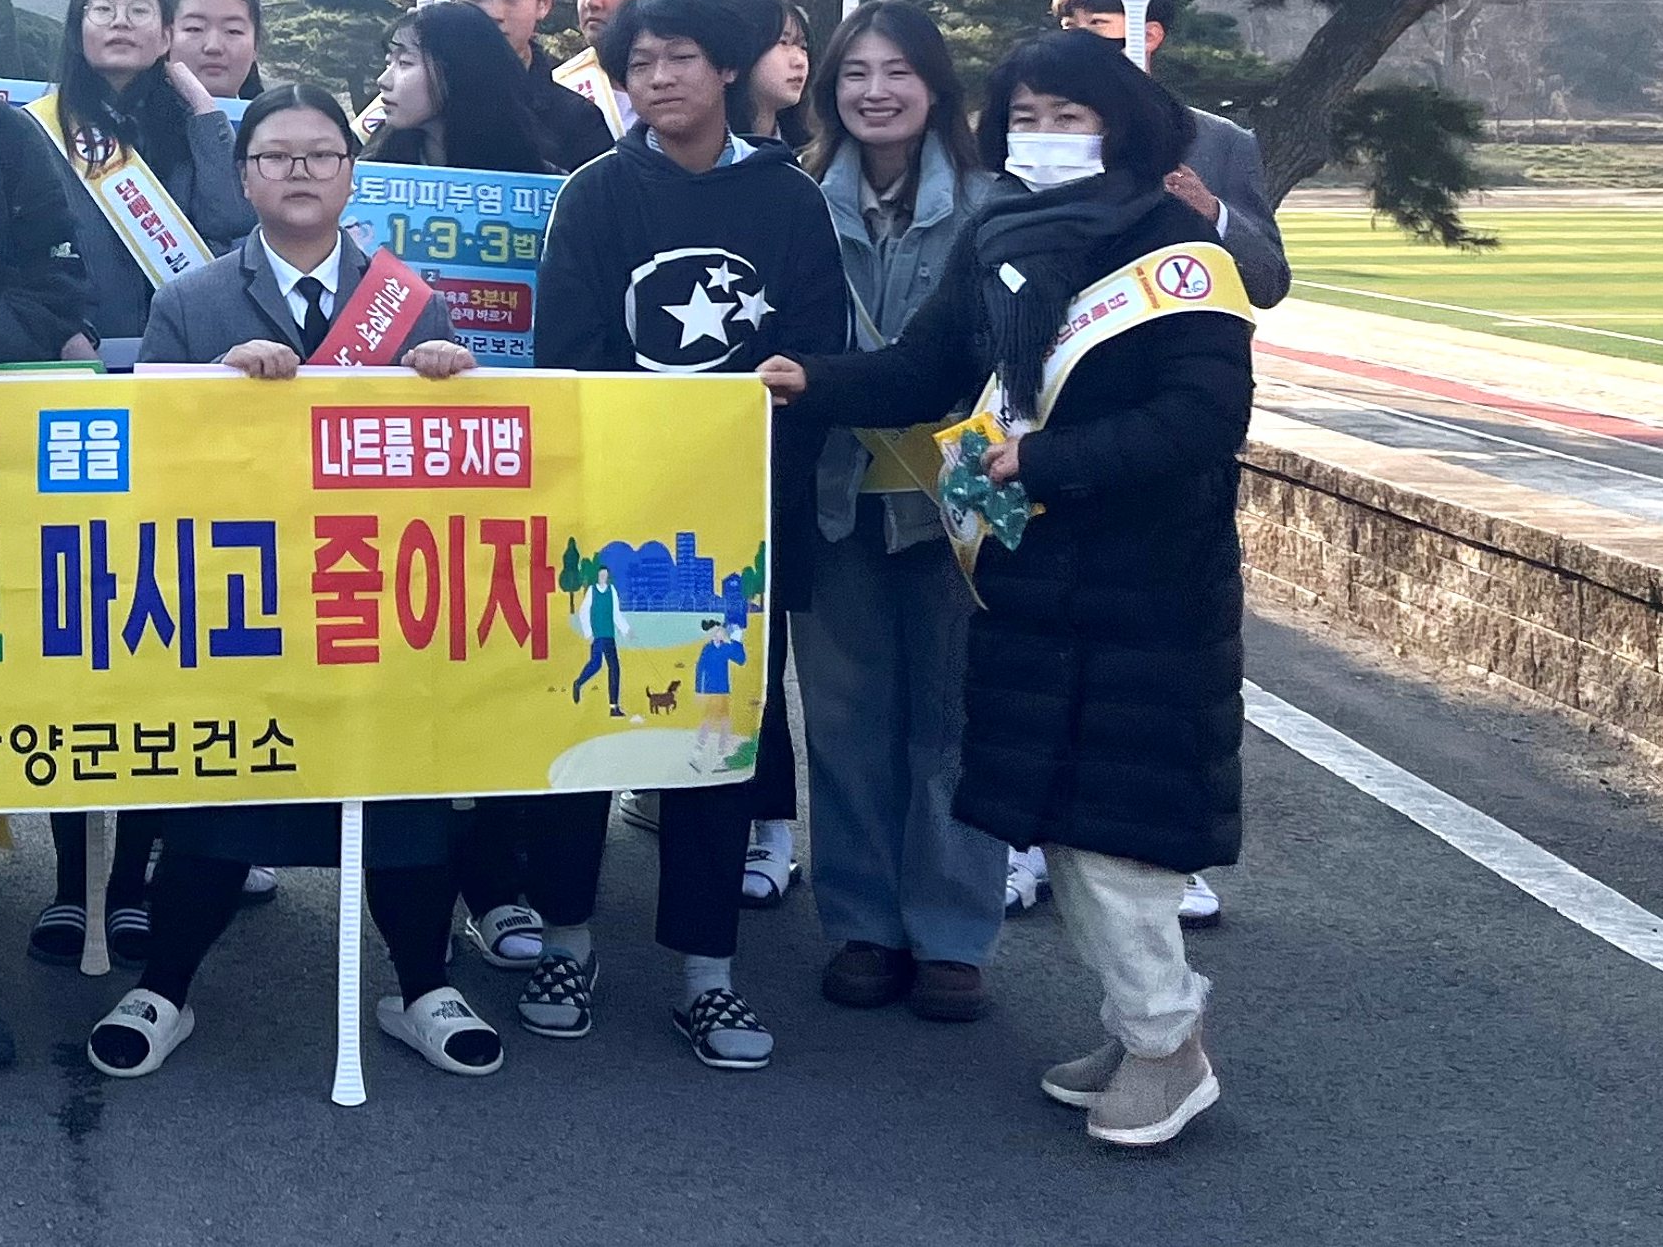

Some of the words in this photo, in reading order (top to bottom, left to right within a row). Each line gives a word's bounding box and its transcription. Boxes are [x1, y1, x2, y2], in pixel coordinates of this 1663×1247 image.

[351, 177, 504, 215] 토피피부염
[426, 271, 436, 282] 2
[48, 419, 121, 481] 물을
[320, 416, 414, 478] 나트륨
[423, 415, 455, 478] 당
[461, 414, 524, 477] 지방
[41, 518, 283, 671] 마시고
[311, 515, 556, 665] 줄이자
[495, 915, 533, 932] PUMA
